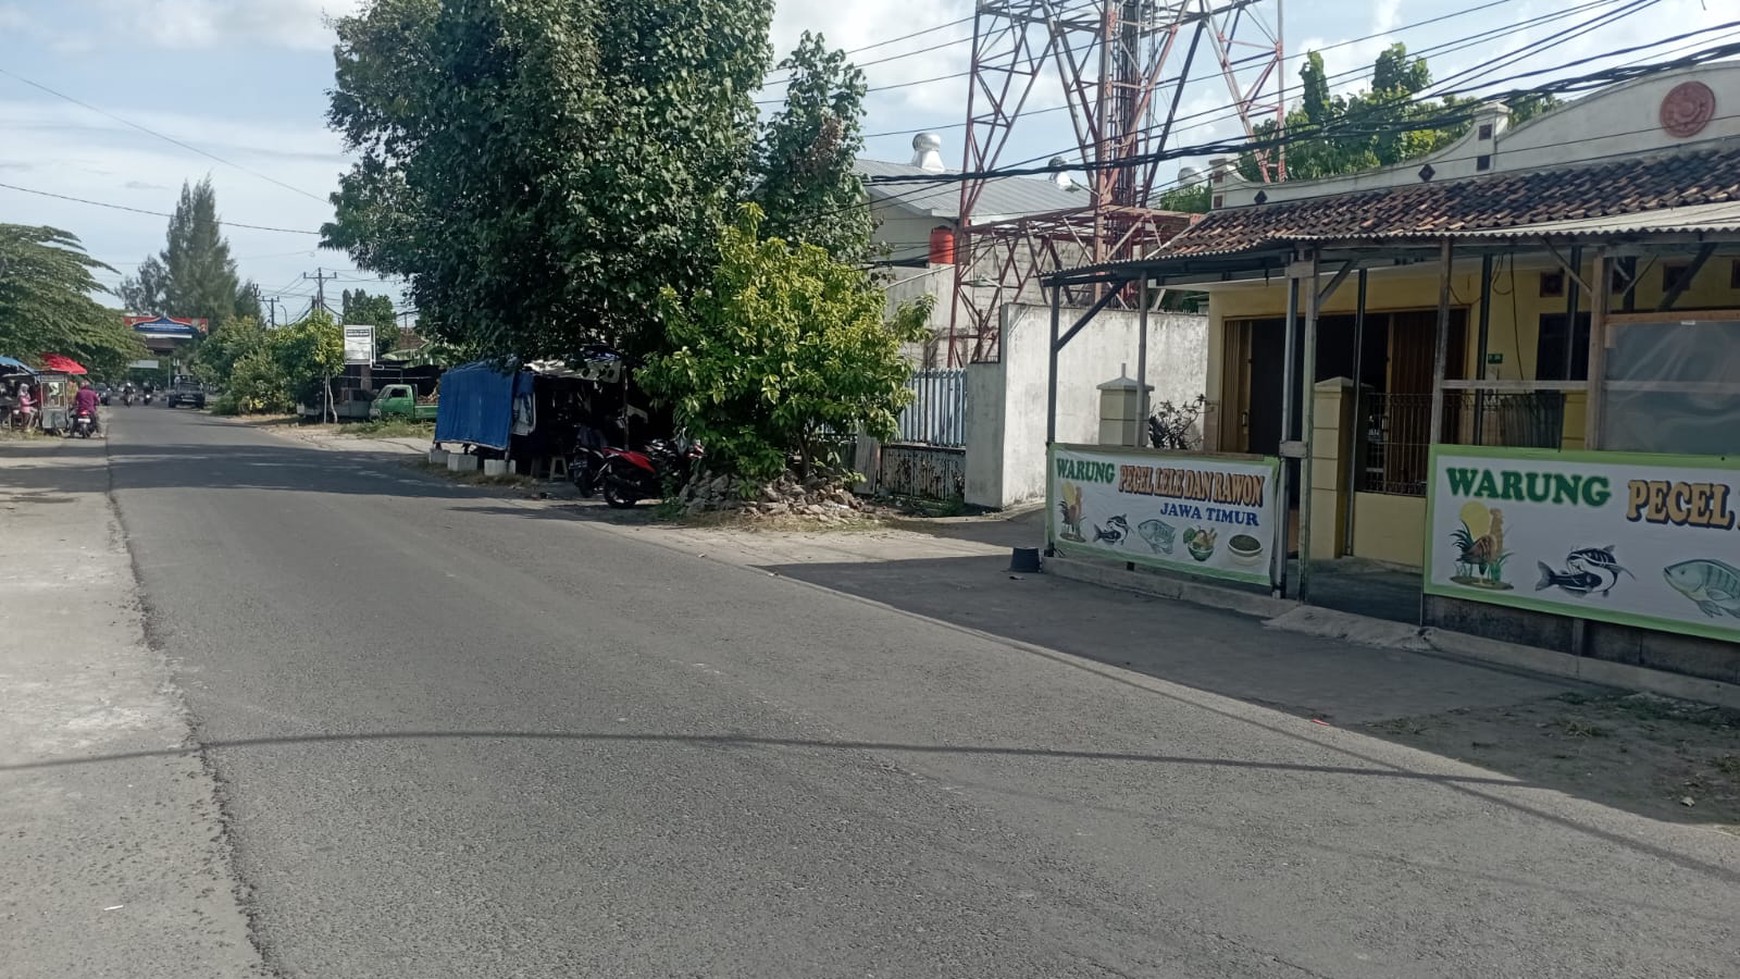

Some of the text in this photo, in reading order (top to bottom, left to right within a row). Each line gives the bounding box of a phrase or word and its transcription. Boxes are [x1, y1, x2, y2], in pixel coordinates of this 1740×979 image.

[1057, 458, 1265, 507] WARUNG PECEL LELE DAN RAWON
[1446, 467, 1735, 530] WARUNG PECEL
[1160, 502, 1260, 526] JAWA TIMUR
